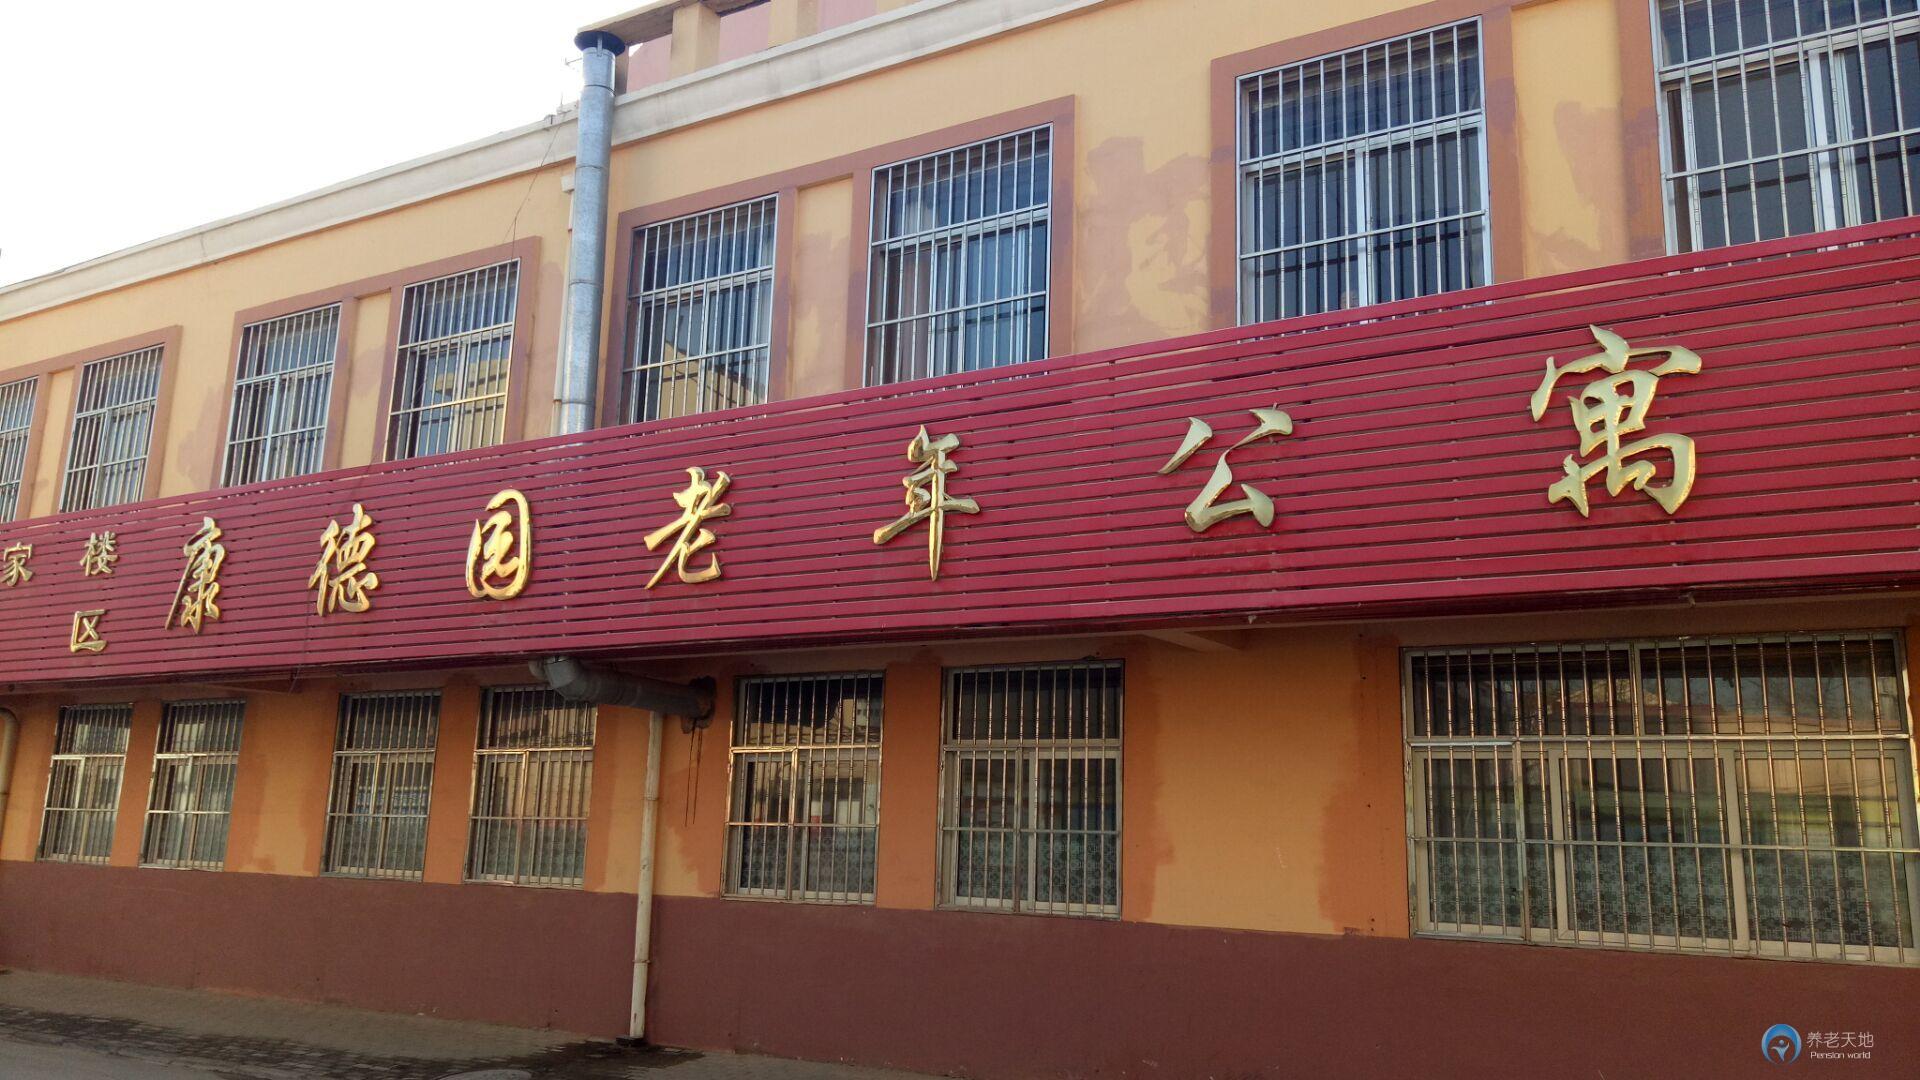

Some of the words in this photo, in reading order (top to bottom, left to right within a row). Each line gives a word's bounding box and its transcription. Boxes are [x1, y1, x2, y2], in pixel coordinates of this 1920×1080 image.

[165, 324, 1702, 634] 康德园老年公寓
[70, 609, 107, 652] 区
